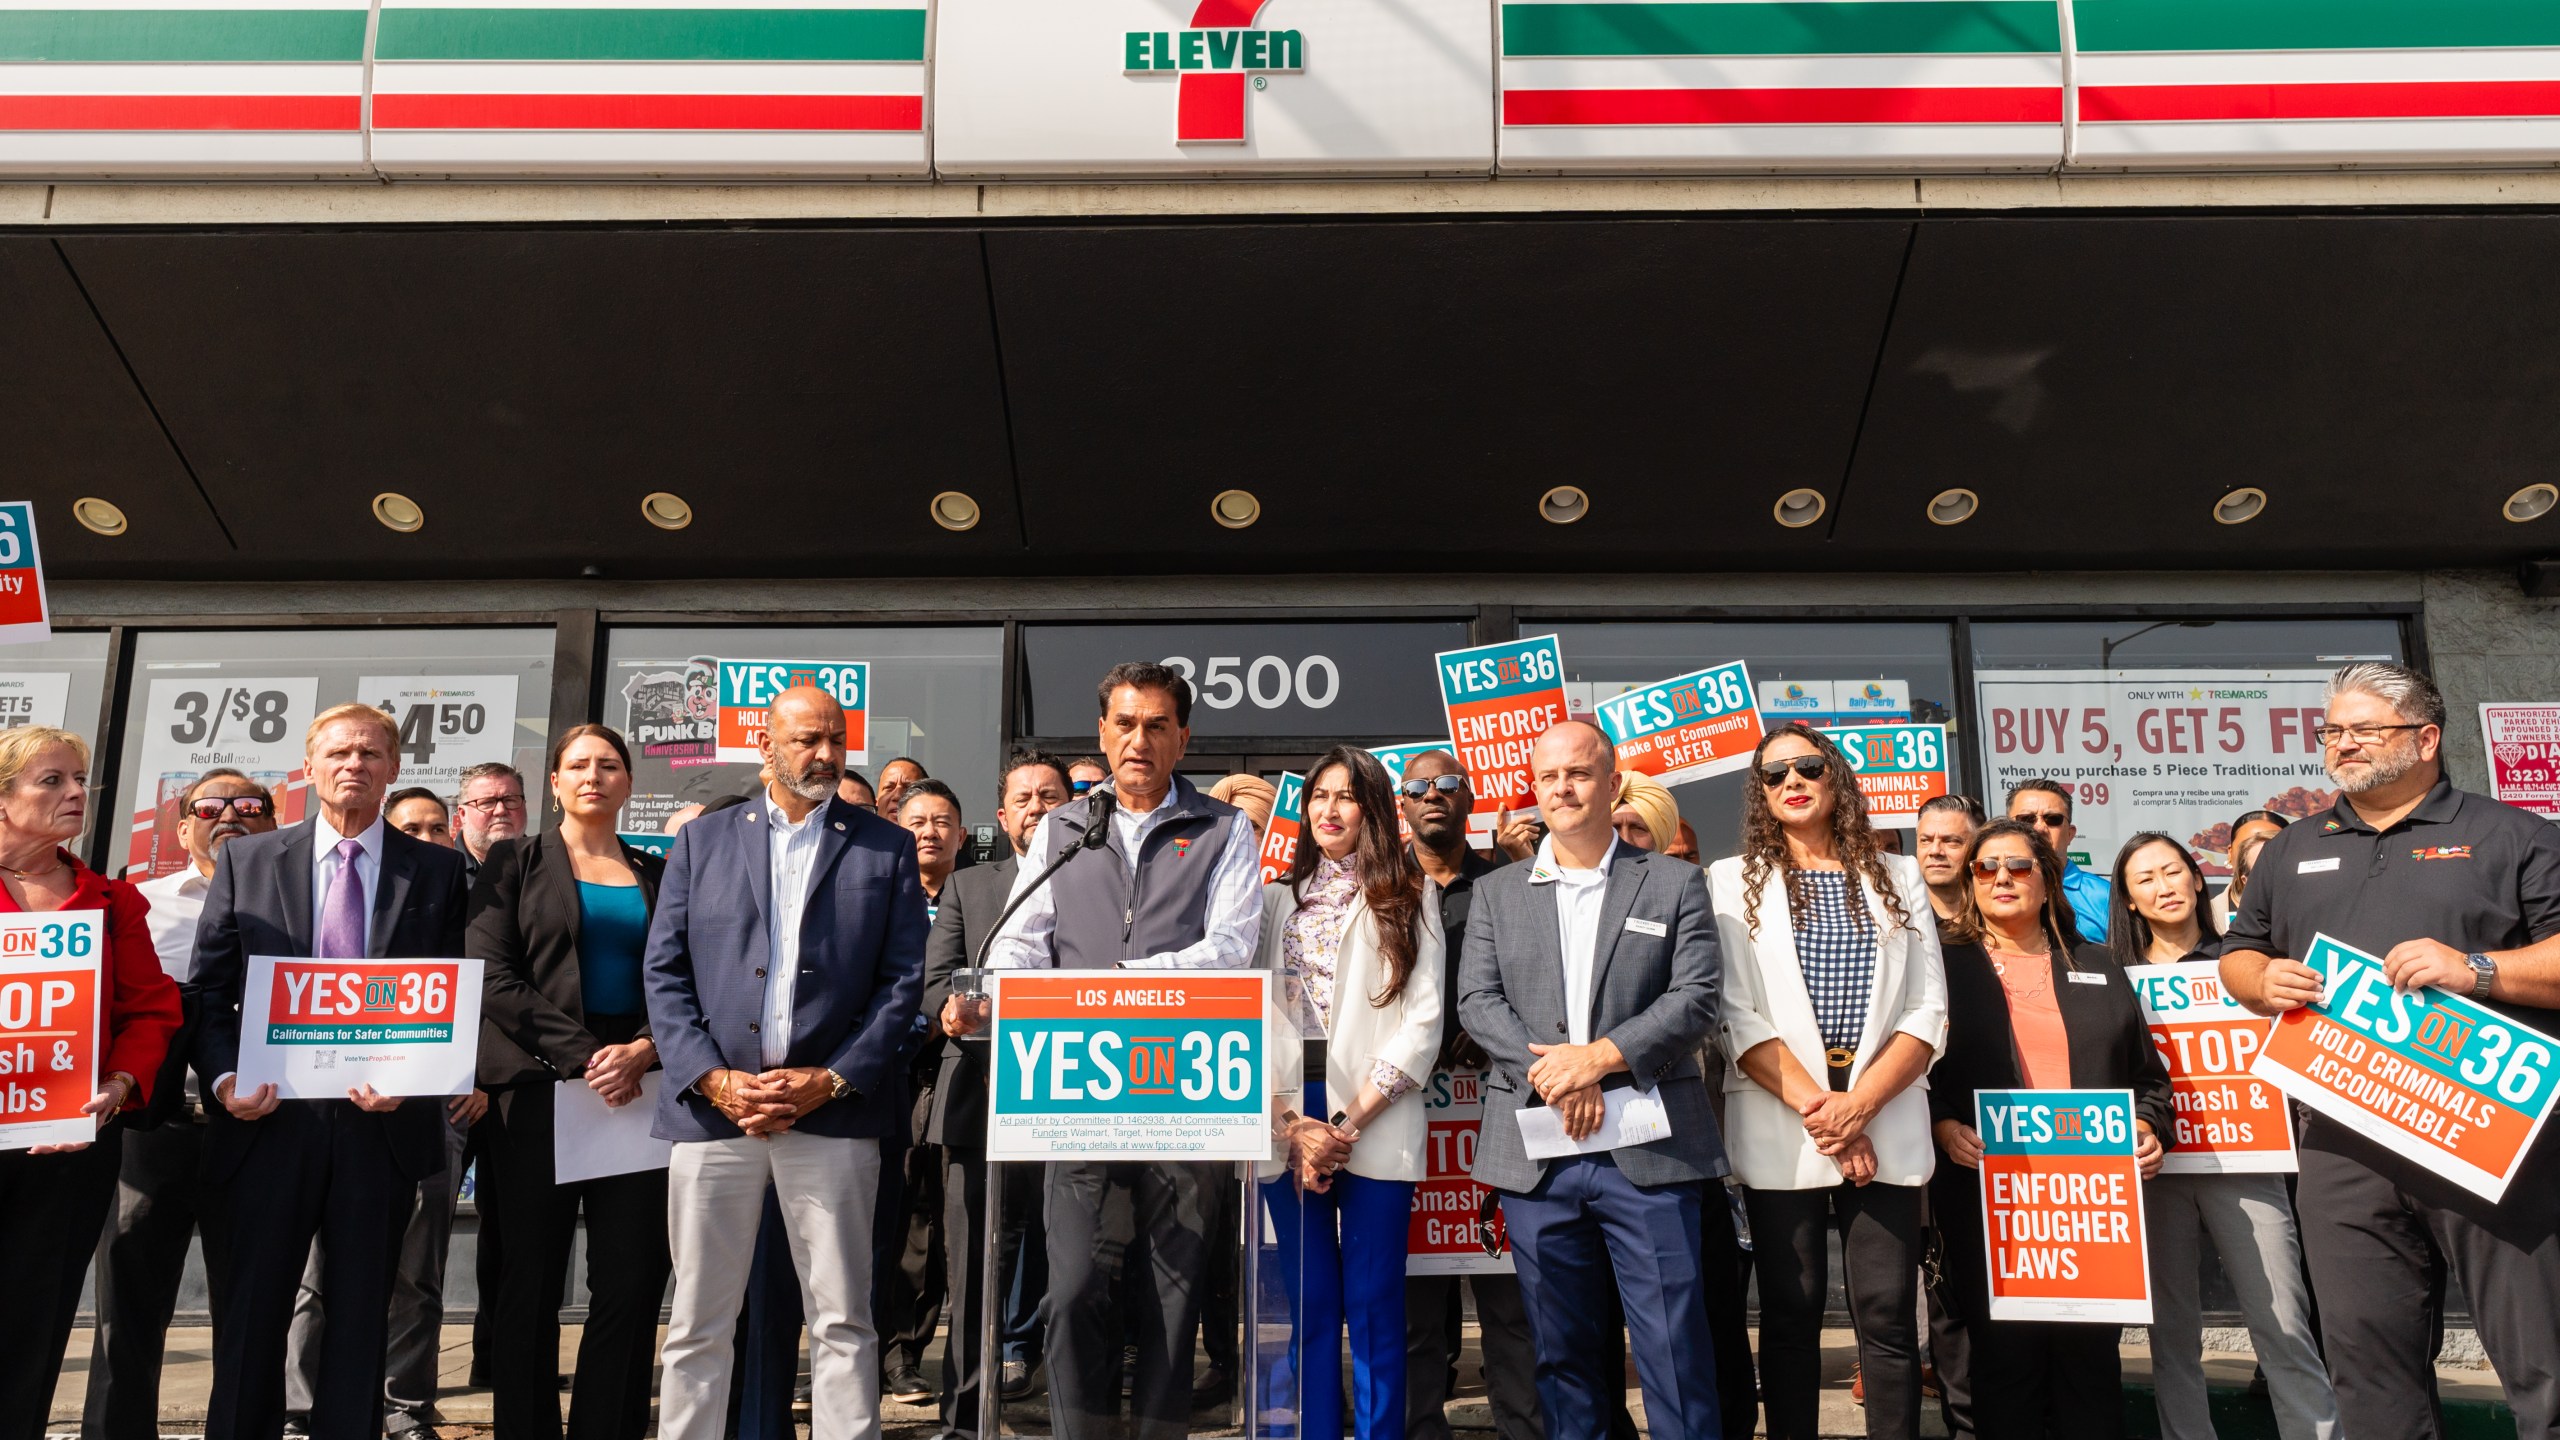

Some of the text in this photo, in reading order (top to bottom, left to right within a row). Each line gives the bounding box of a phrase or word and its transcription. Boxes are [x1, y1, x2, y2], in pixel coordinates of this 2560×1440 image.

[727, 666, 788, 704] YES
[1446, 648, 1556, 694] YES ON 36
[21, 696, 33, 712] 5
[1604, 670, 1744, 740] YES ON 36
[1773, 697, 1818, 709] Fantasy 5
[1848, 698, 1868, 708] Daily
[2128, 690, 2268, 700] ONLY WITH 7REWARDS
[638, 723, 694, 742] PUNK
[1457, 704, 1558, 743] ENFORCE
[1618, 715, 1749, 760] Make Our Community
[1992, 707, 2326, 763] BUY 5, GET 5 FR
[190, 753, 210, 764] Red
[213, 752, 234, 764] Bull
[235, 756, 245, 764] (12
[645, 743, 700, 756] ANNIVERSARY
[1461, 738, 1536, 772] TOUGH
[1662, 740, 1715, 768] SAFER
[1866, 740, 1894, 762] ON
[1896, 730, 1938, 769] 36
[2526, 743, 2560, 760] DIA
[400, 768, 415, 776] ces
[417, 767, 432, 776] and
[435, 767, 458, 777] Large
[1469, 770, 1530, 800] LAWS
[1998, 764, 2294, 780] when you purchase 5 Piece Traditional
[2506, 769, 2549, 782] (323)
[630, 801, 645, 810] Buy
[652, 801, 673, 810] Large
[1868, 794, 1920, 812] NTABLE
[2132, 789, 2163, 798] Compra
[2180, 790, 2186, 798] y
[2187, 789, 2210, 797] recibe
[2227, 788, 2249, 798] gratis
[2133, 798, 2244, 808] al comprar 5 Alitas tradicionales
[3, 922, 92, 958] ON 36
[284, 972, 448, 1016] YES ON 36
[1076, 989, 1186, 1007] LOS ANGELES
[2192, 980, 2219, 1001] ON
[0, 980, 76, 1030] OP
[272, 1028, 448, 1040] Californians for Safer Communities
[2318, 948, 2550, 1104] YES ON 36
[50, 1040, 74, 1072] &
[1008, 1030, 1252, 1102] YES ON 36
[2308, 1020, 2366, 1064] HOLD
[2367, 1052, 2496, 1129] CRIMINALS
[1454, 1080, 1478, 1100] ON
[2171, 1082, 2270, 1112] mash &
[2306, 1054, 2466, 1149] ACCOUNTABLE
[1000, 1116, 1012, 1125] Ad
[1014, 1116, 1033, 1126] paid
[1035, 1116, 1047, 1124] for
[1050, 1116, 1060, 1126] by
[1062, 1116, 1112, 1124] Committee
[1114, 1116, 1124, 1124] ID
[1170, 1116, 1182, 1124] Ad
[1185, 1116, 1238, 1124] Committee's
[1241, 1116, 1258, 1126] Top
[1032, 1128, 1225, 1138] Funders Walmart, Target, Home Depot USA
[1986, 1104, 2126, 1144] YES ON 36
[2175, 1117, 2254, 1145] Grabs
[1051, 1140, 1205, 1151] Funding details at www.fppc.ca.gov
[1430, 1129, 1478, 1173] TO
[1993, 1172, 2128, 1206] ENFORCE
[1993, 1209, 2131, 1244] TOUGHER
[1999, 1248, 2080, 1280] LAWS
